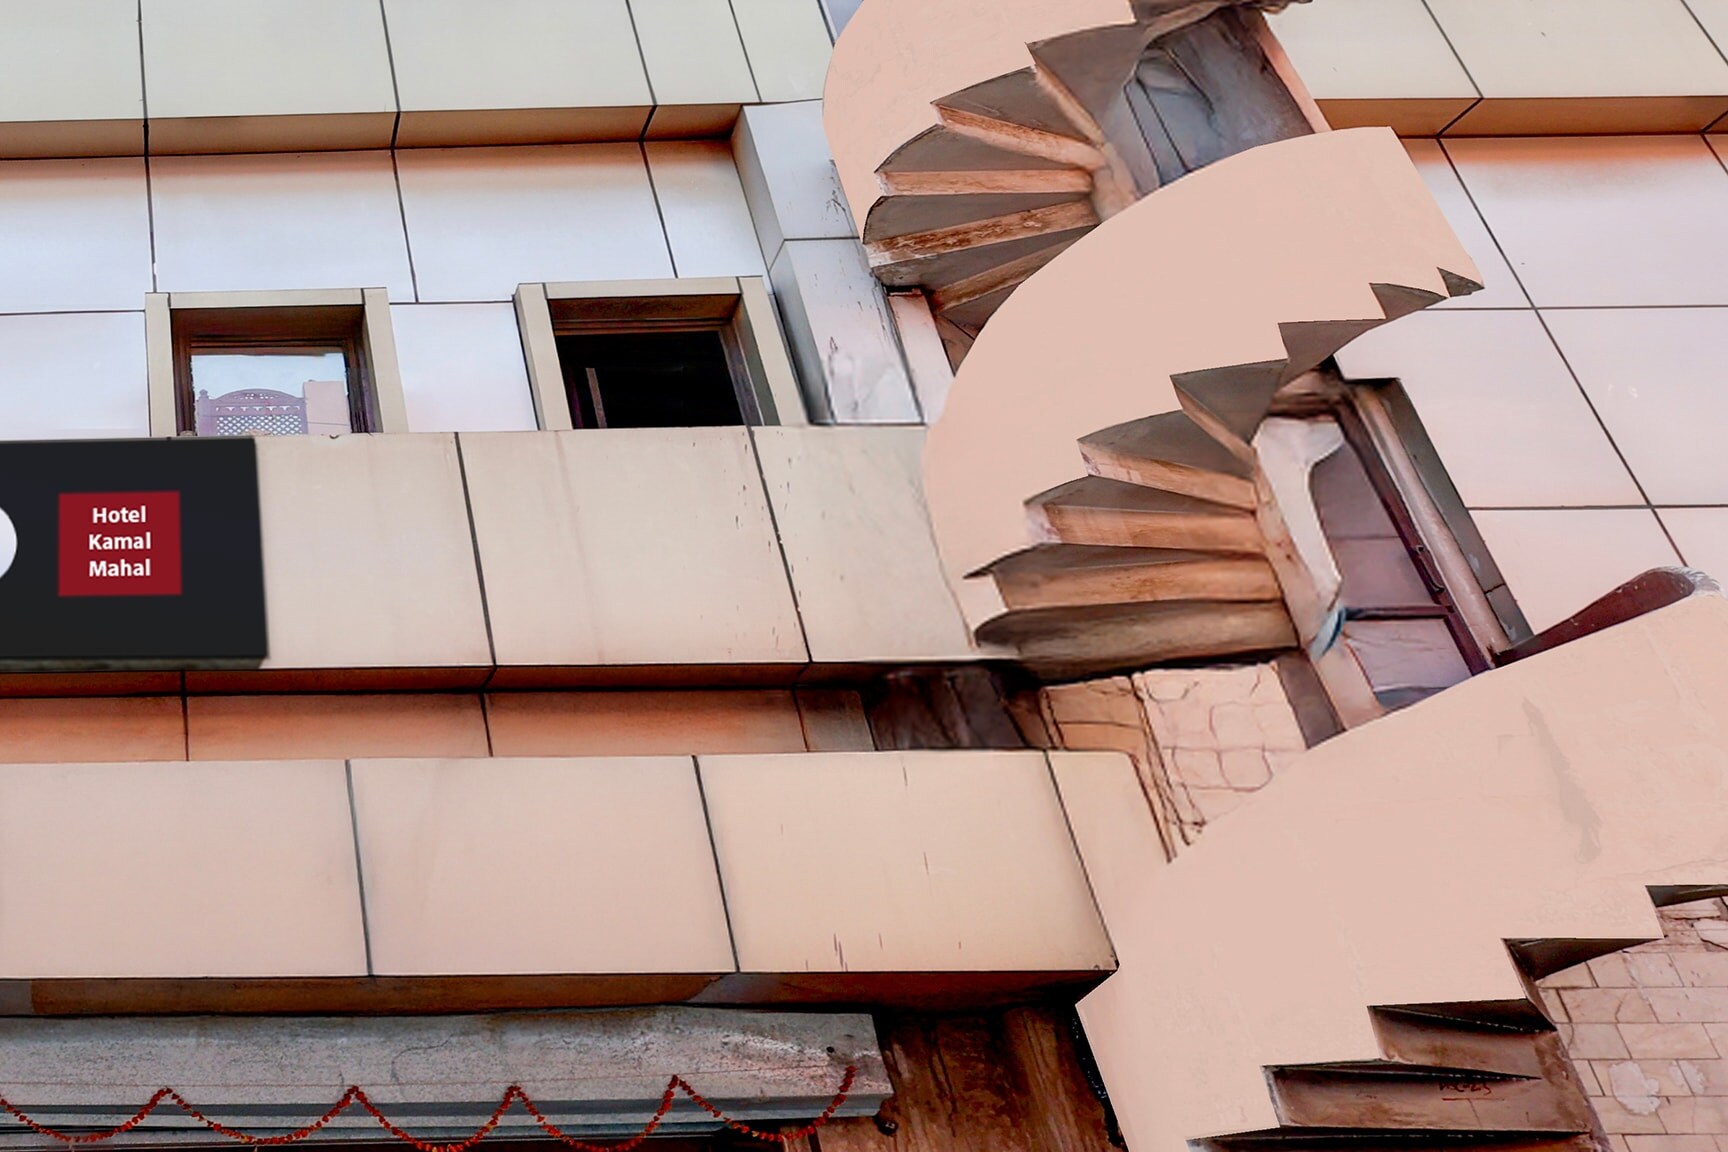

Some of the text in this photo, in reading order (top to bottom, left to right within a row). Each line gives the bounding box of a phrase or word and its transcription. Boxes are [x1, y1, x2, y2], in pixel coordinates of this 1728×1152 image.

[92, 505, 146, 524] Hotel
[88, 531, 151, 550] Kamal
[88, 558, 151, 577] Mahal
